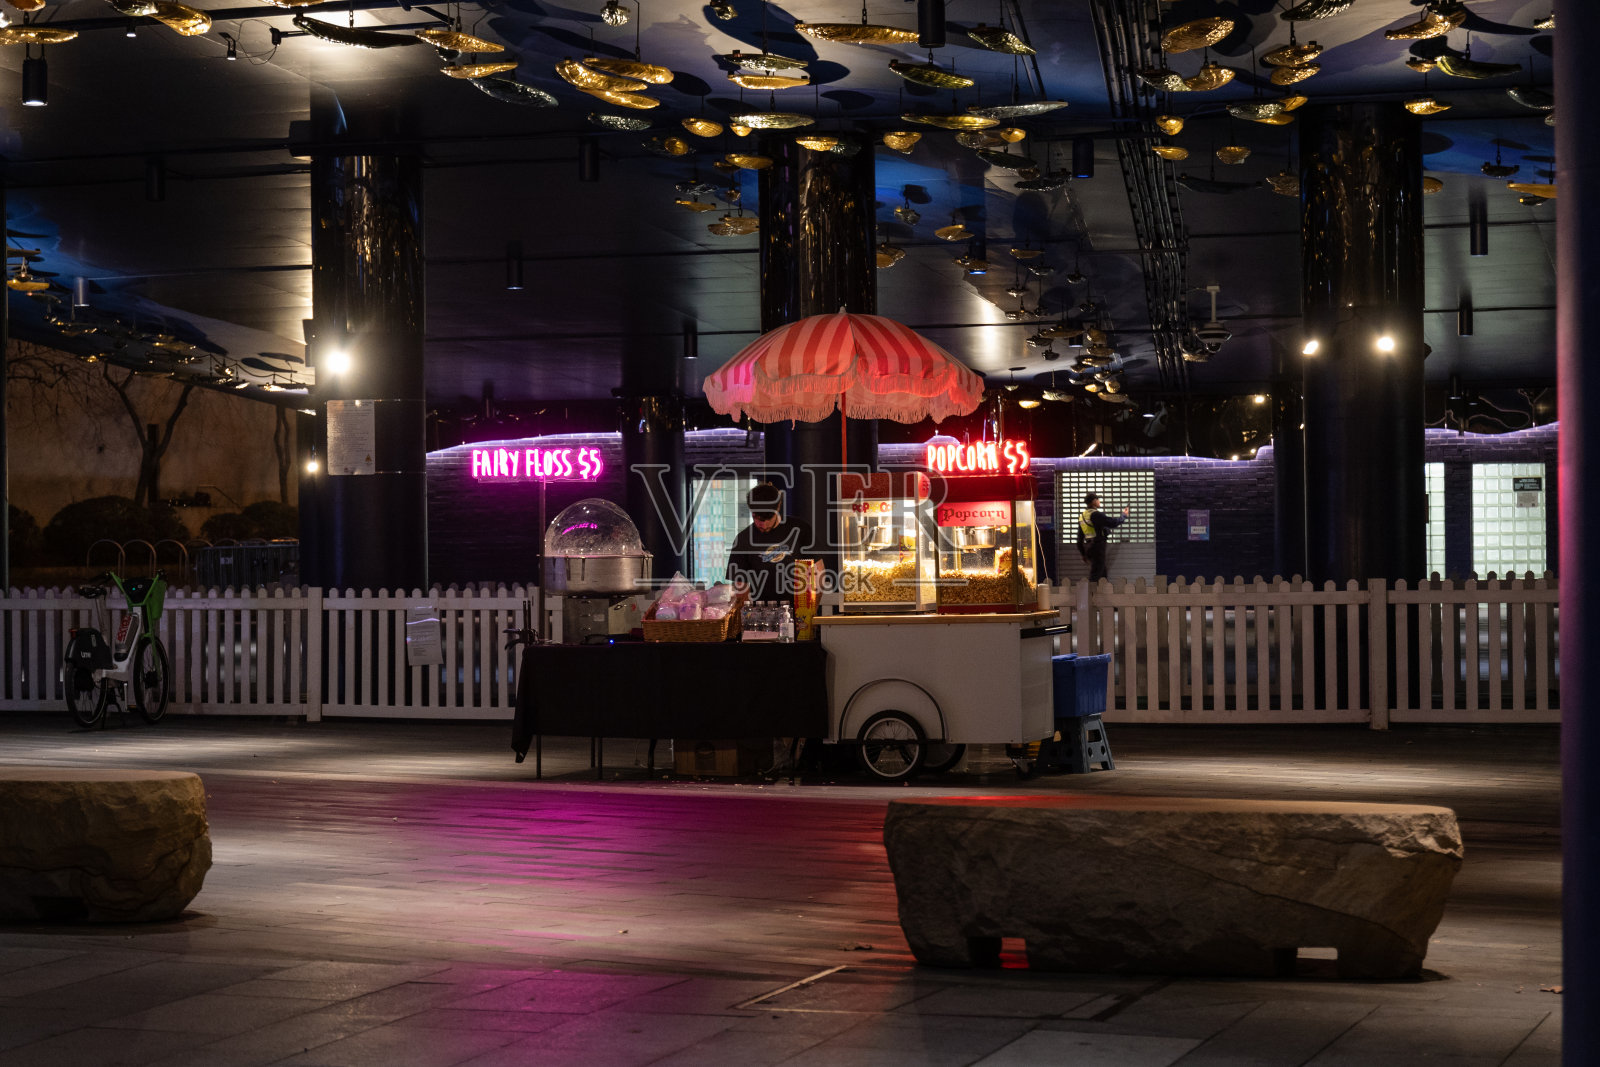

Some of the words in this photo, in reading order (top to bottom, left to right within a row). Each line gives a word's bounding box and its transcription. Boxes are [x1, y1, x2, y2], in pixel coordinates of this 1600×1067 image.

[472, 448, 519, 477] FAIRY
[525, 448, 573, 477] FLOSS
[578, 447, 602, 480] $5
[927, 443, 998, 471] POPCORN
[1004, 441, 1028, 473] $5
[941, 508, 1008, 523] Popcorn
